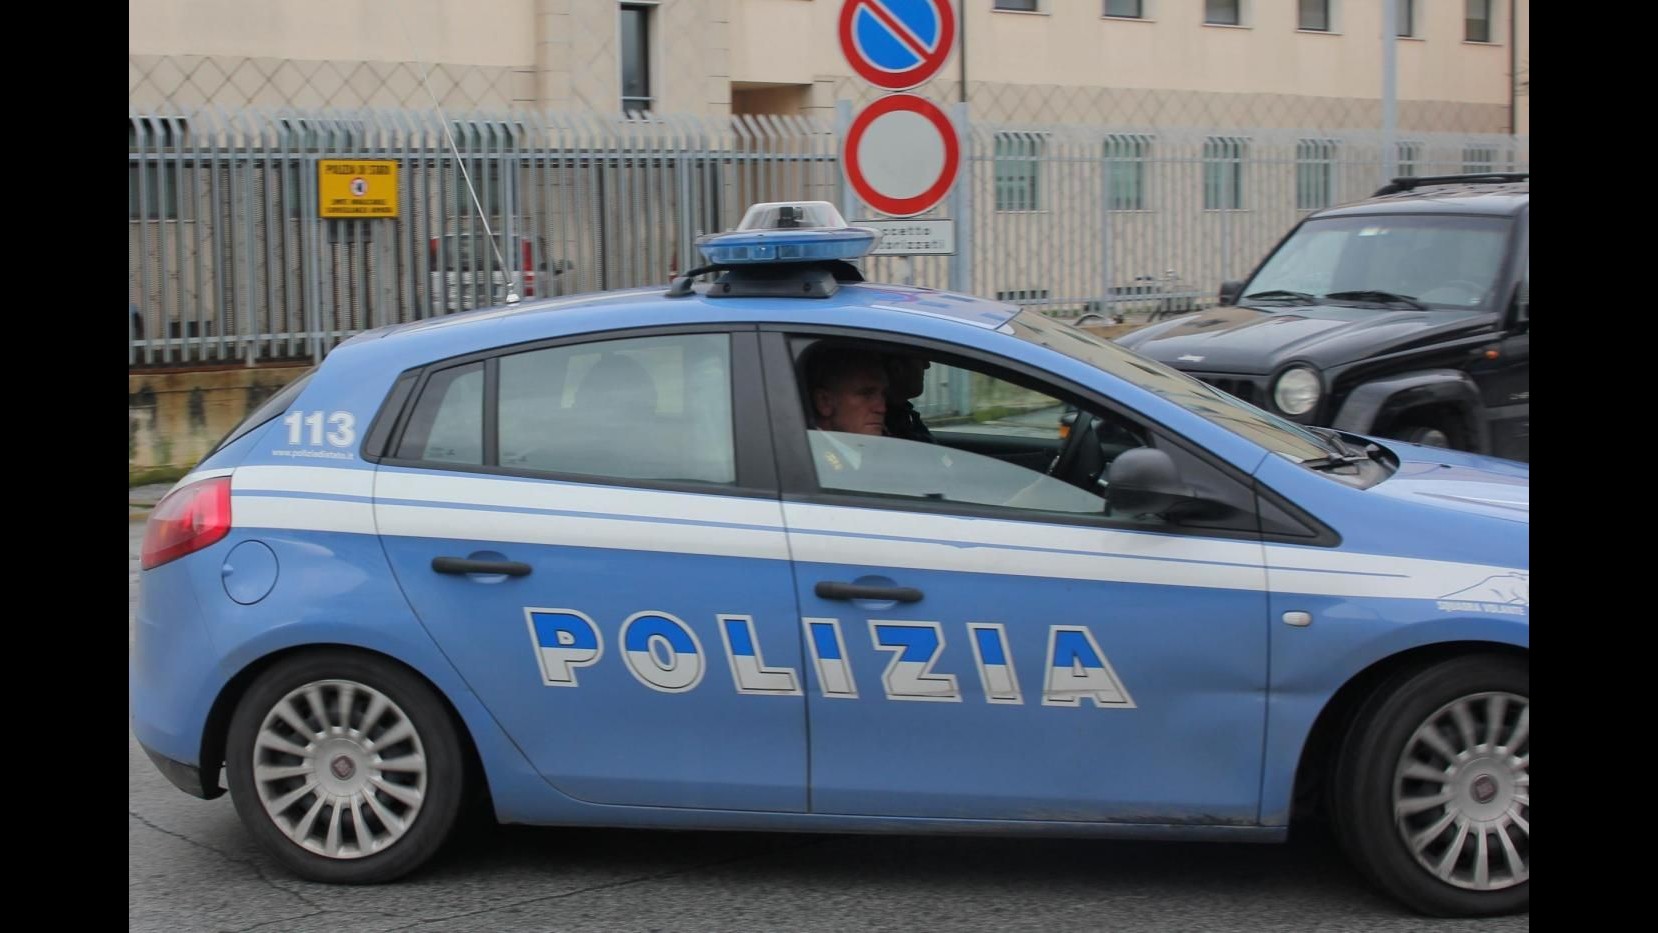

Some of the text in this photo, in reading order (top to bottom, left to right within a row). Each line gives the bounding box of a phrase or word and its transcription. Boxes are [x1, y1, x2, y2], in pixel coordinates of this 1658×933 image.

[883, 227, 930, 236] ccetto
[880, 239, 945, 249] torizzati
[285, 410, 355, 448] 113
[1481, 603, 1525, 615] VOLANTE
[522, 606, 1138, 709] POLIZIA
